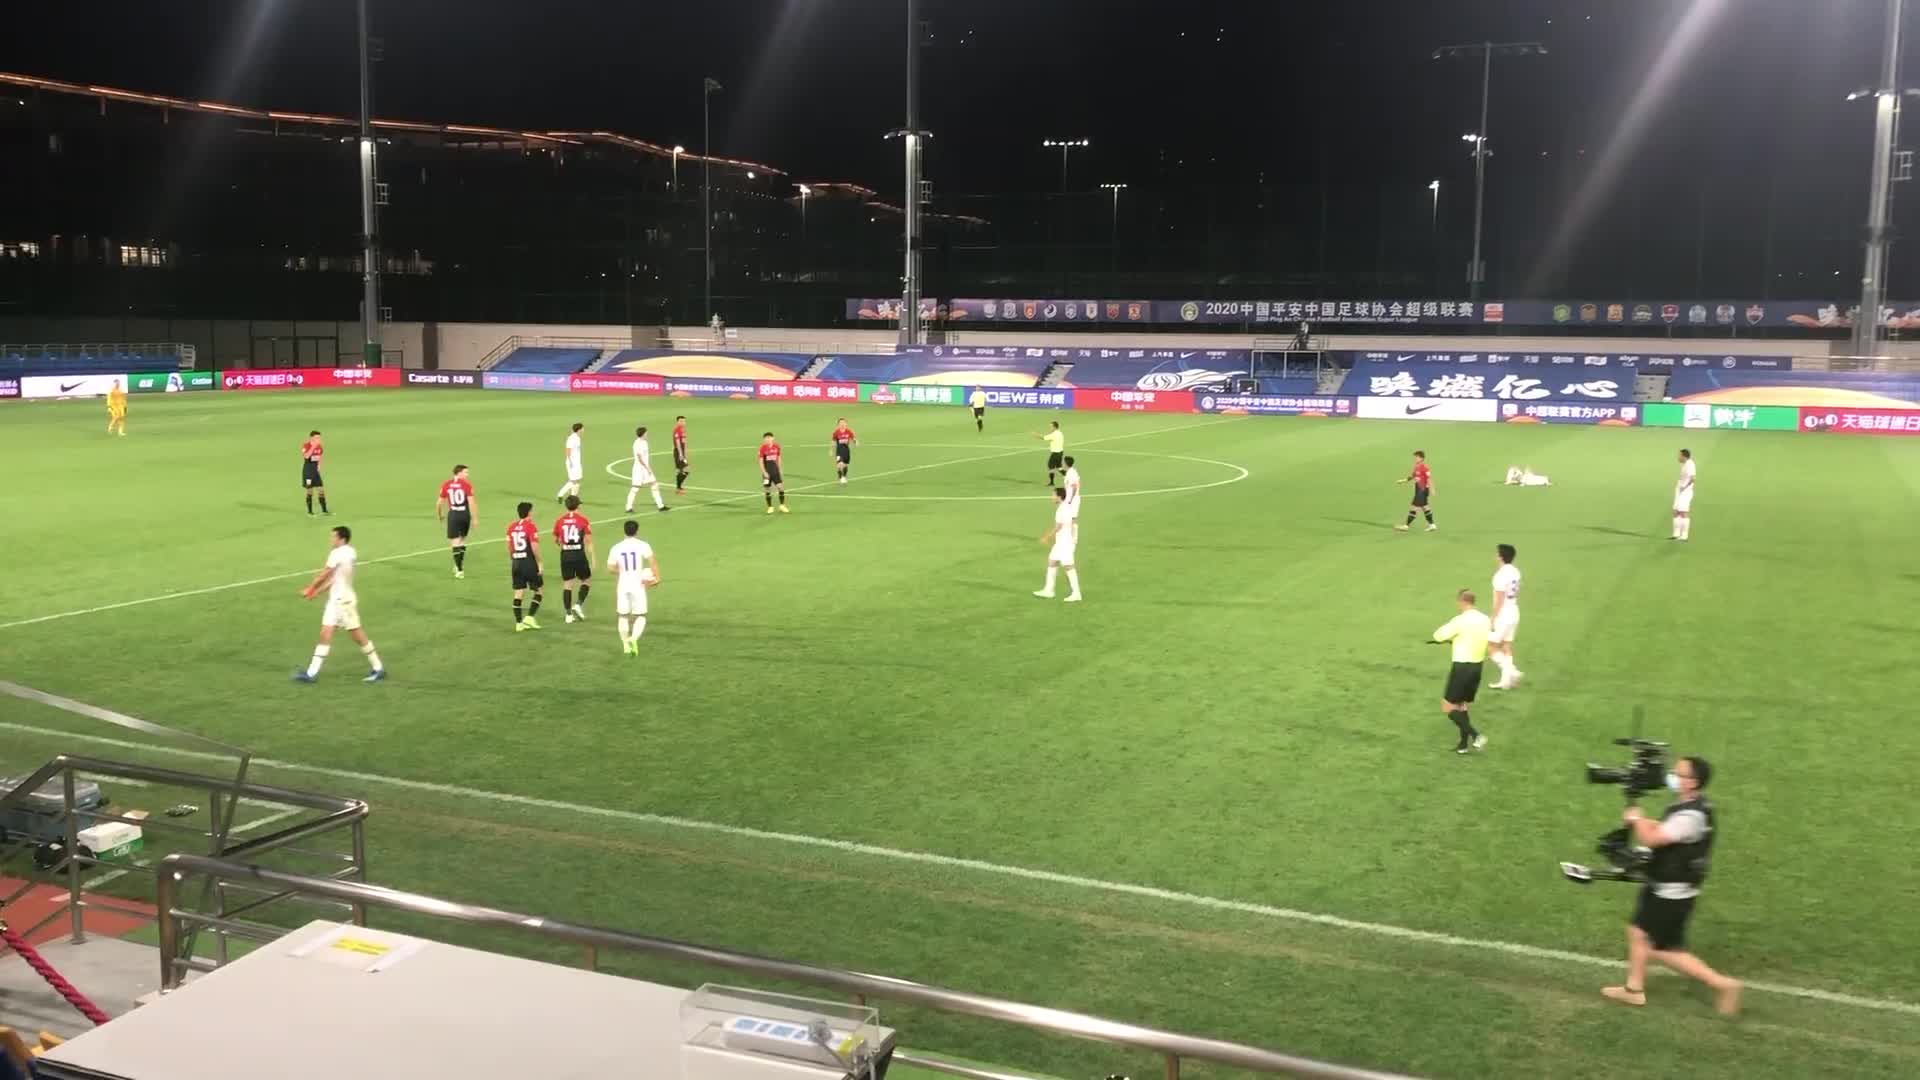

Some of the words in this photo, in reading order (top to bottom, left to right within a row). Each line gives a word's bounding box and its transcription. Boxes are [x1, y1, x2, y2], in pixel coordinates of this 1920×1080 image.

[1206, 301, 1474, 317] 2020中国平安中国足球协会超级联赛
[447, 488, 465, 505] 10
[511, 531, 527, 551] 15
[562, 524, 580, 543] 14
[620, 551, 637, 571] 11
